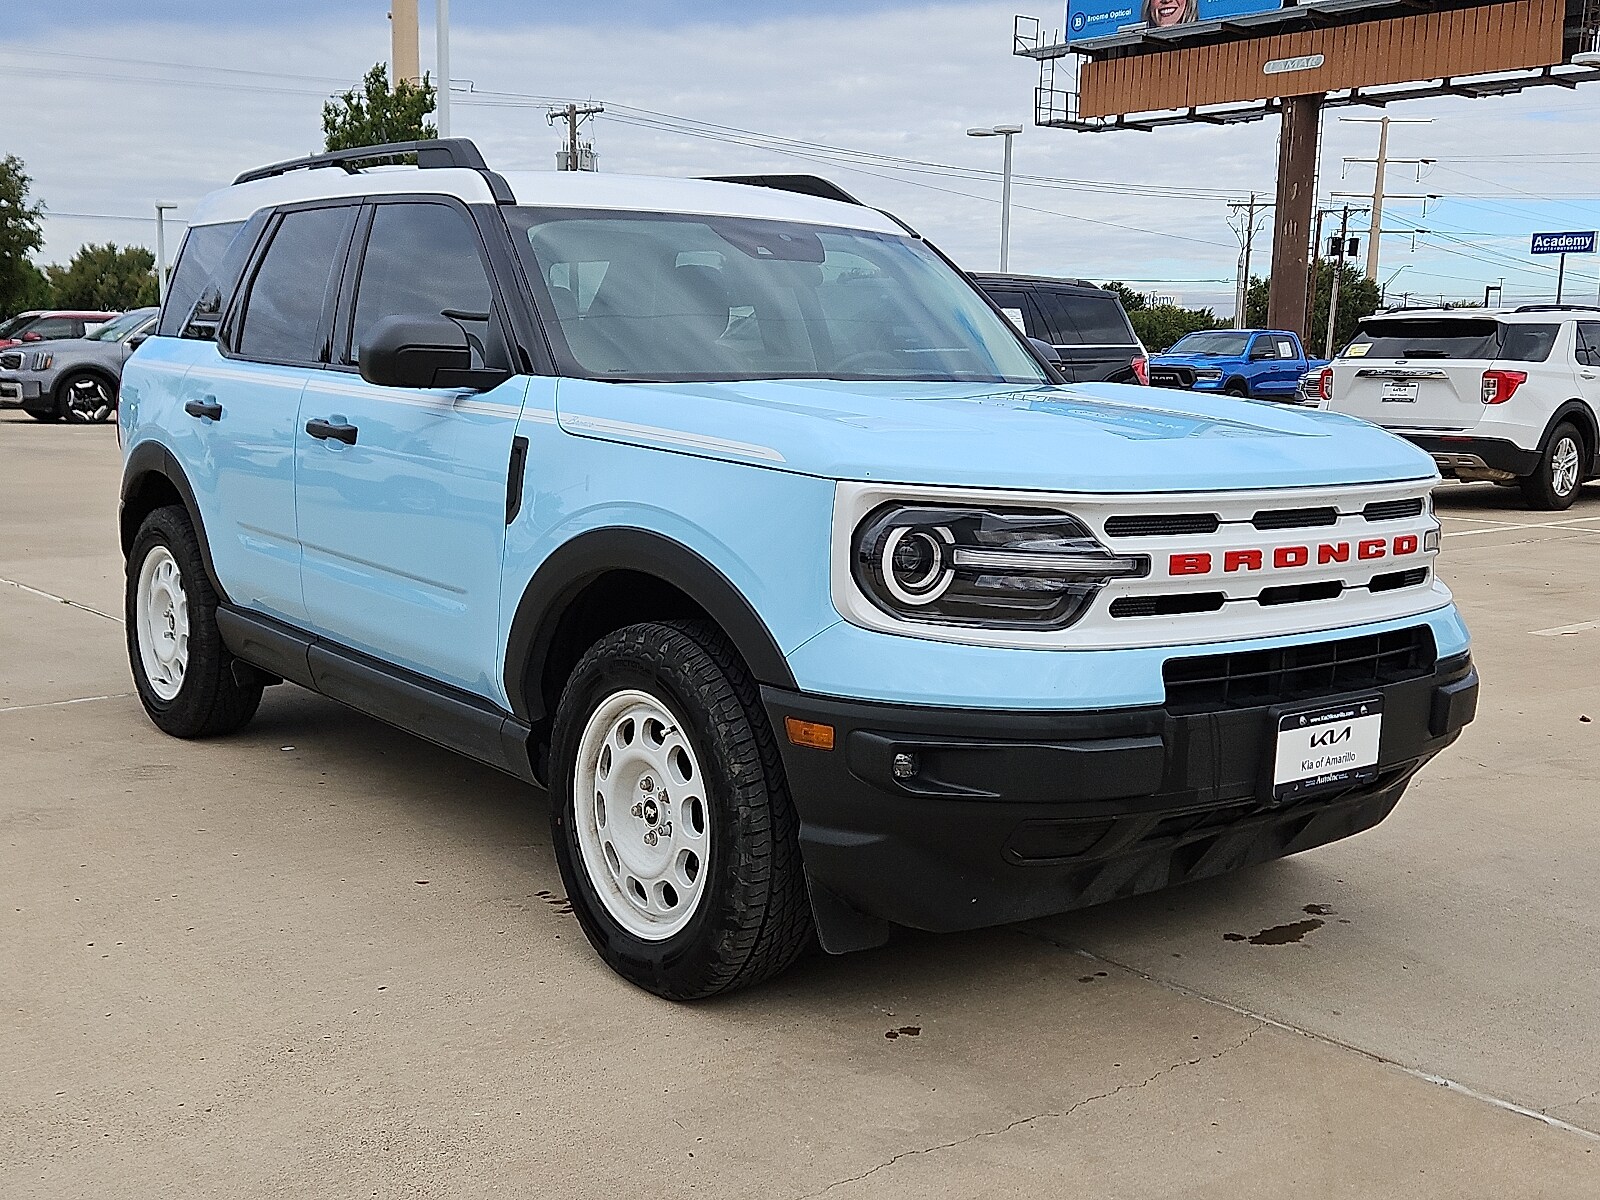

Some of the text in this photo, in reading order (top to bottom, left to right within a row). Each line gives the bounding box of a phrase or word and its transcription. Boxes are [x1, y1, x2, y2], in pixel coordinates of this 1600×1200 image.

[1087, 8, 1132, 22] Broome Optical
[1534, 235, 1592, 249] Academy
[1144, 293, 1175, 306] demy
[1168, 534, 1418, 576] BRONCO
[1310, 726, 1352, 748] KIA
[1301, 752, 1356, 772] Kia of Amarillo
